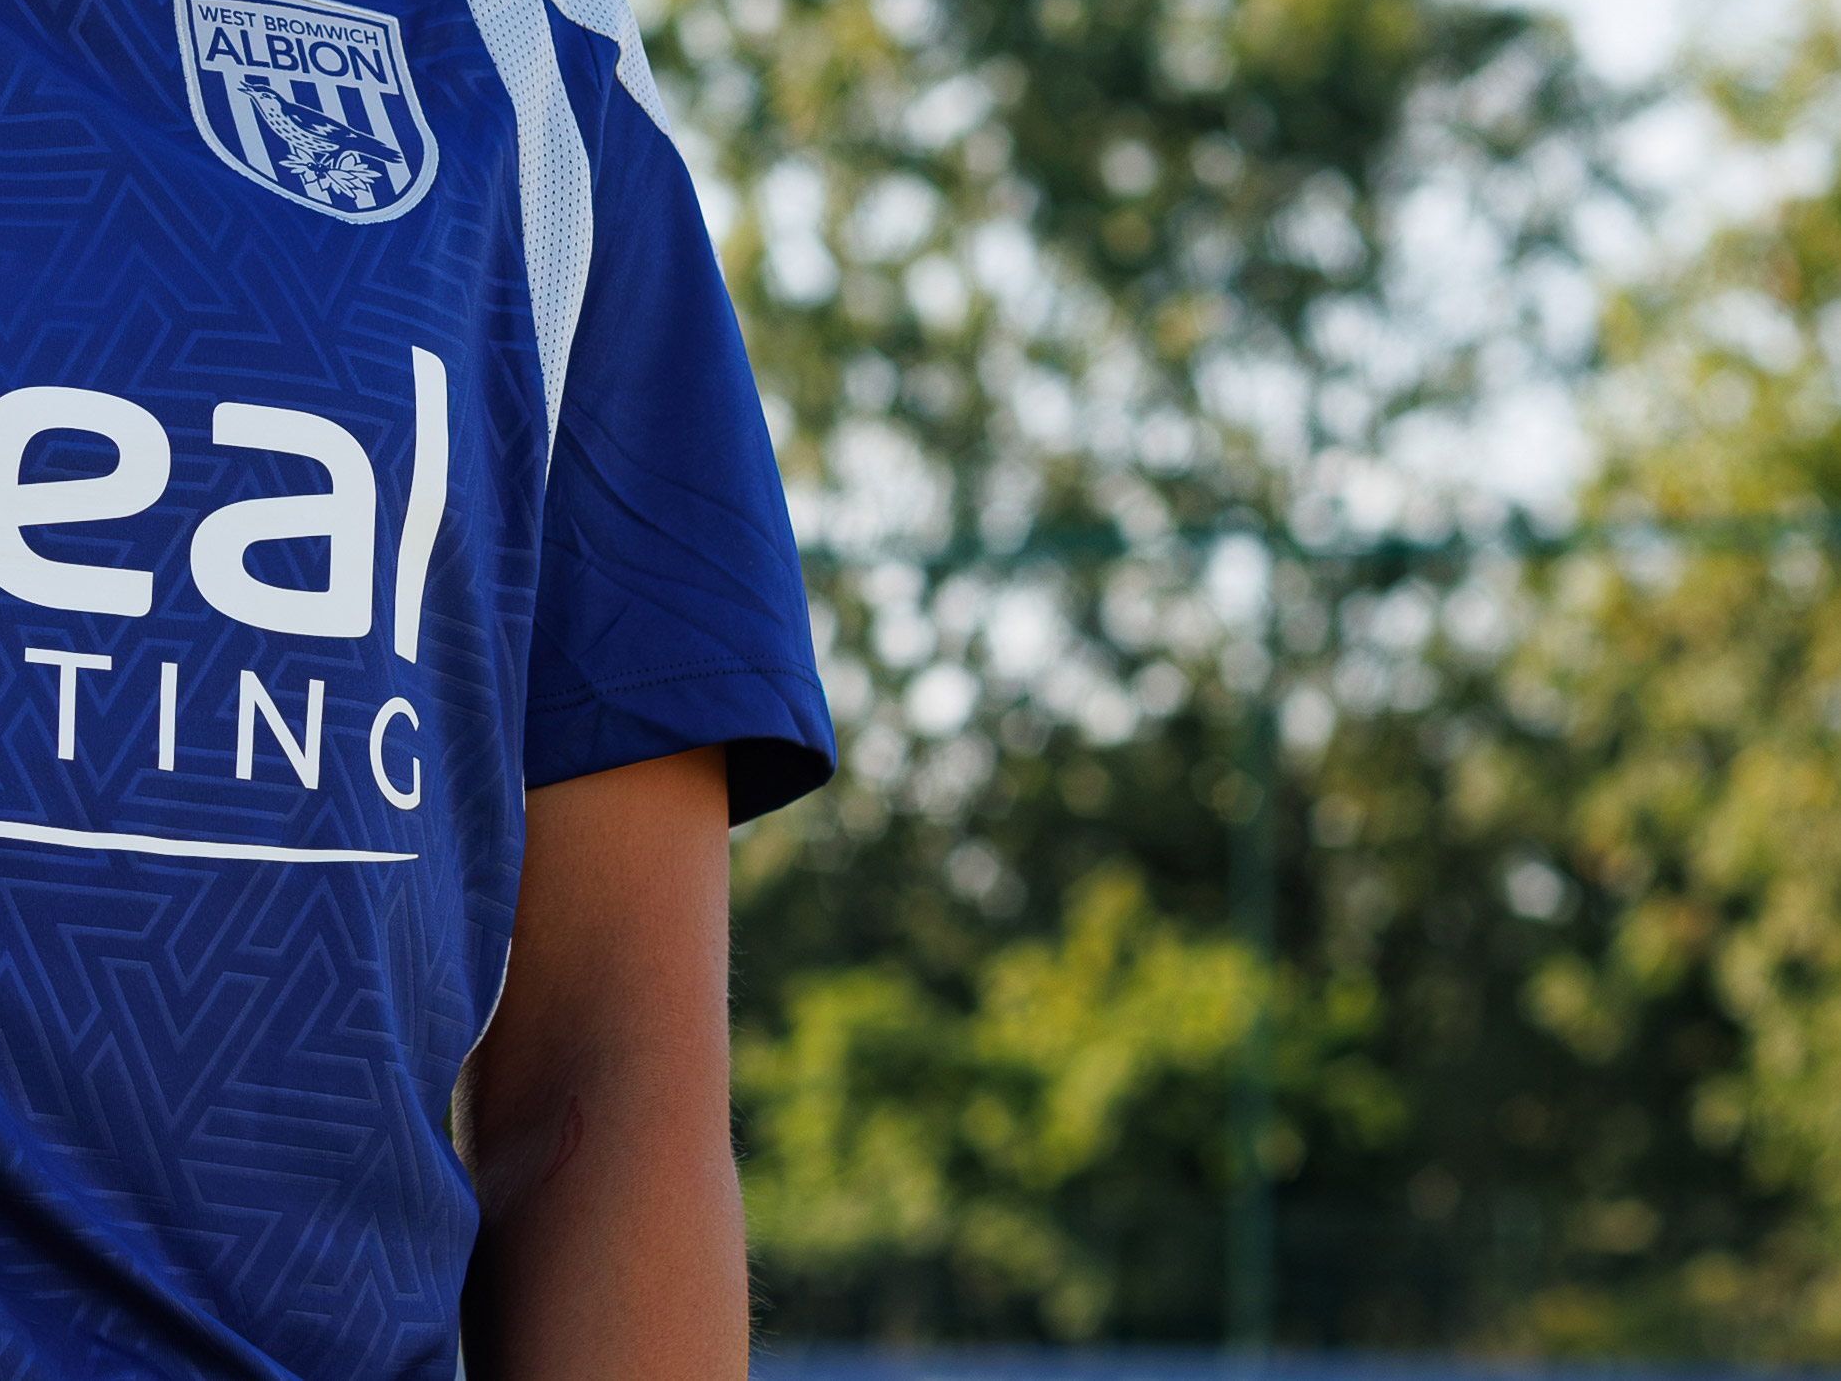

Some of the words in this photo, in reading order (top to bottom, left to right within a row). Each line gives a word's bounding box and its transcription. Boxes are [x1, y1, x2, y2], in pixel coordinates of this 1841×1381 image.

[198, 4, 256, 27] WEST
[263, 15, 379, 46] BROMWICH
[205, 26, 389, 85] ALBION
